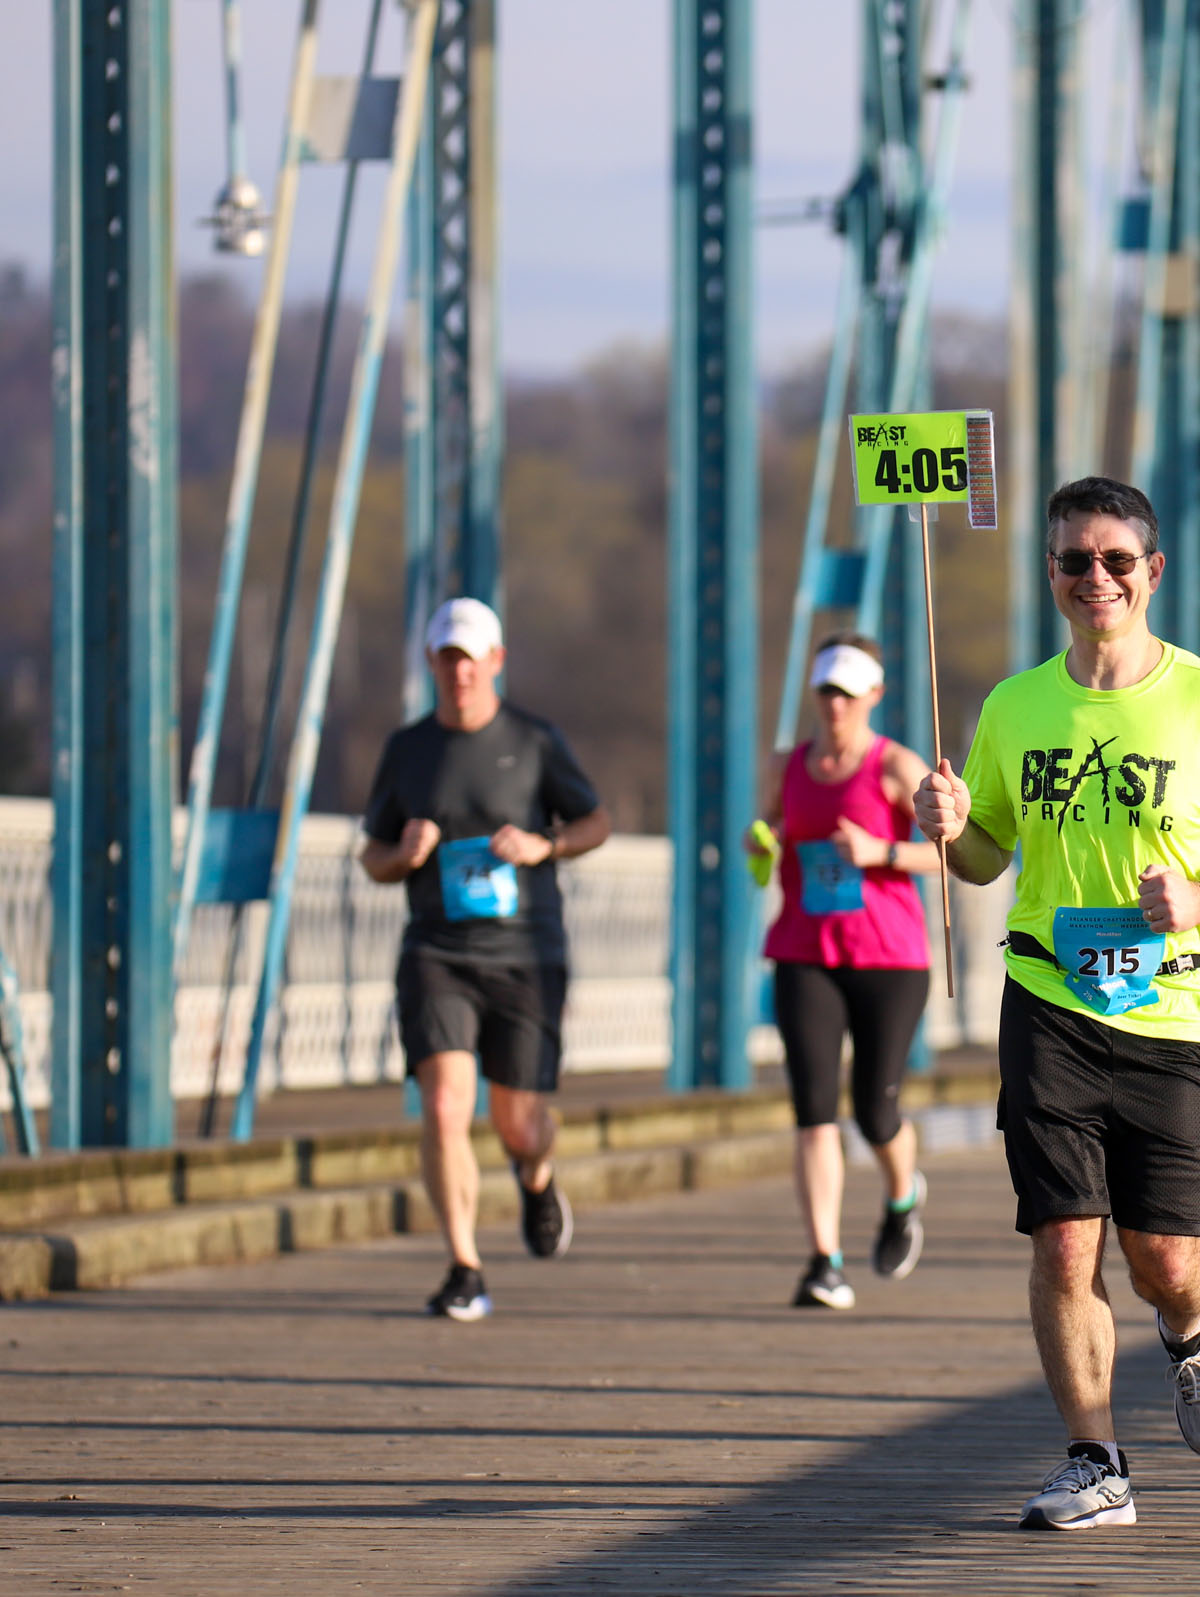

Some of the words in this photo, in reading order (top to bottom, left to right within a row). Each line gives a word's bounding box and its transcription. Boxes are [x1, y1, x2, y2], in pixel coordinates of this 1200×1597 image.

[857, 422, 907, 451] BEAST
[874, 447, 968, 494] 4:05
[1021, 736, 1176, 838] BEAST
[1022, 803, 1174, 832] PACING
[1078, 947, 1140, 976] 215
